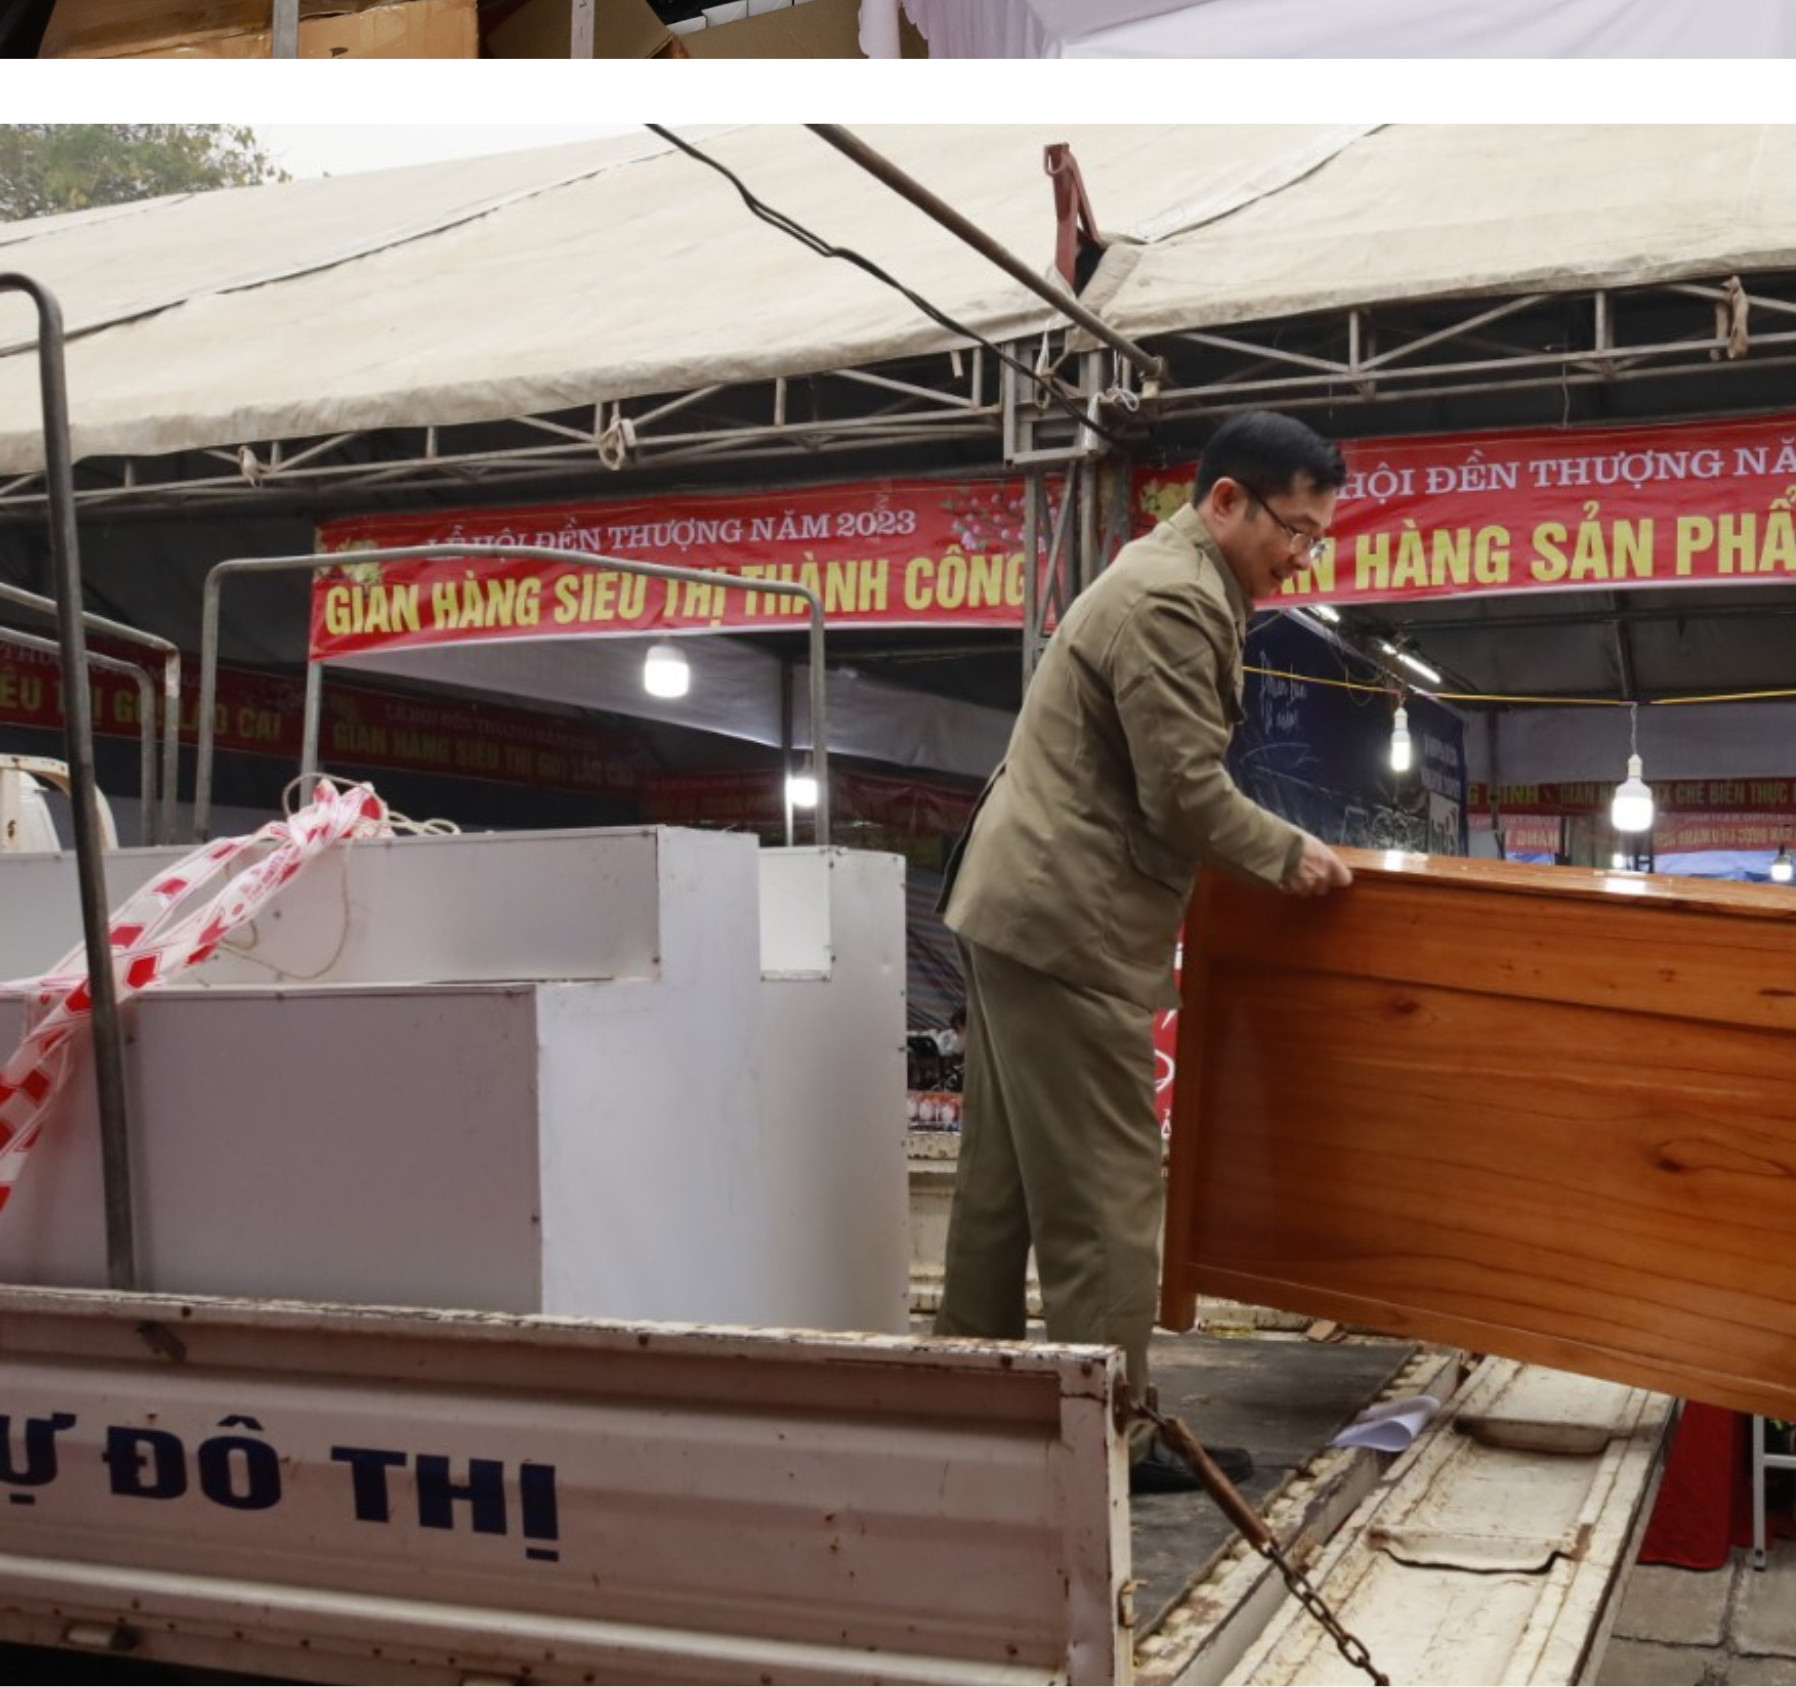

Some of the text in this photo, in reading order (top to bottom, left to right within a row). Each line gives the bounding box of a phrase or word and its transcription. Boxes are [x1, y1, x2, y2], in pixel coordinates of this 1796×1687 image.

[1340, 459, 1416, 507] HỘI
[1424, 448, 1519, 496] ĐỀN
[1528, 446, 1726, 493] THƯỢNG
[607, 517, 743, 554] THƯỢNG
[749, 509, 830, 542] NĂM
[836, 509, 917, 538] 2023
[1354, 517, 1511, 591] HÀNG
[1530, 500, 1654, 583] SẢN
[325, 583, 426, 636] GIAN
[432, 569, 541, 630] HÀNG
[904, 545, 1027, 611] CÔNG
[102, 1414, 561, 1563] ĐÔ THỊ
